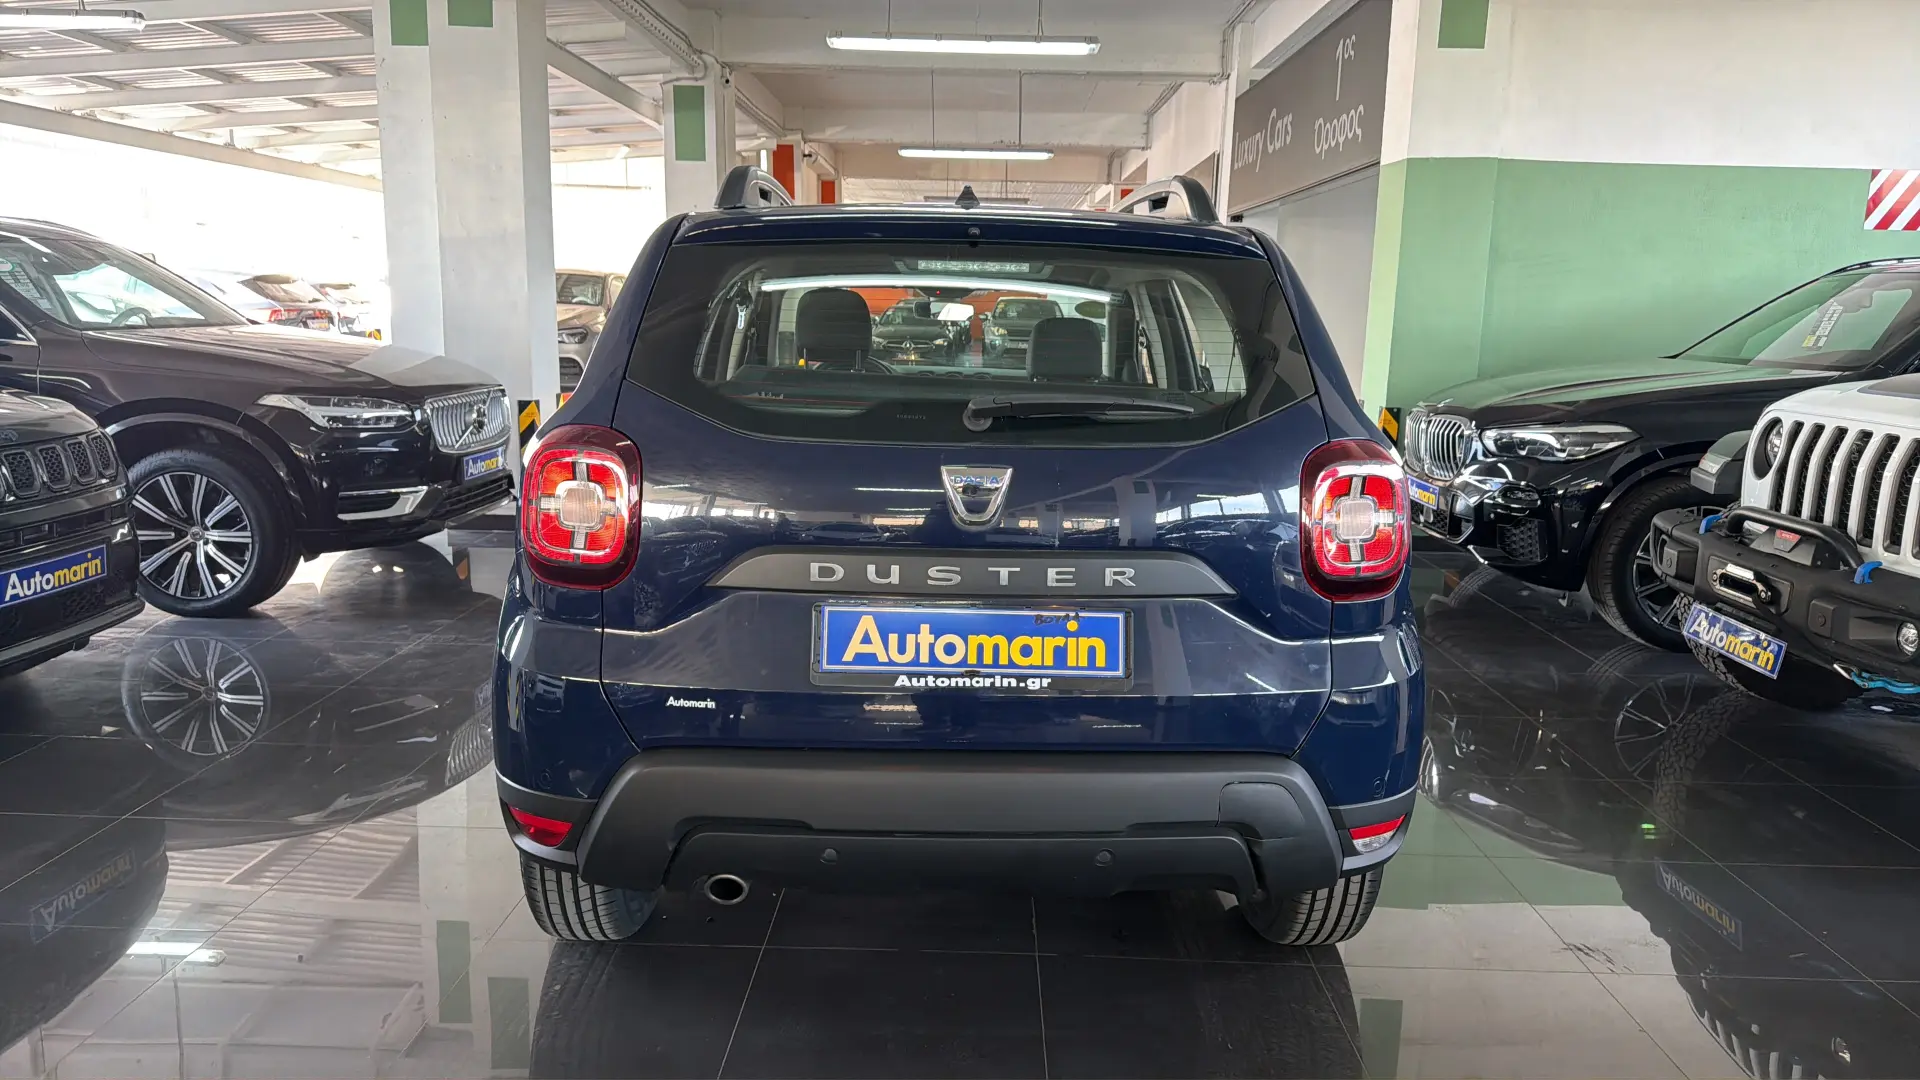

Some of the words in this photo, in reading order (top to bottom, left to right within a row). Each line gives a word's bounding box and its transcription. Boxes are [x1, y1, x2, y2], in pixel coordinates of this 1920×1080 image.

[1335, 34, 1356, 102] 1ος
[1233, 128, 1266, 172] Luxury
[1266, 107, 1293, 153] Cars
[1314, 104, 1364, 160] Όροφος
[4, 552, 102, 602] Automarin
[809, 562, 1136, 587] DUSTER
[841, 614, 1107, 668] Automarin
[1689, 612, 1775, 671] Automarin
[665, 696, 716, 709] Automarin
[894, 674, 1052, 691] Automarin.gr
